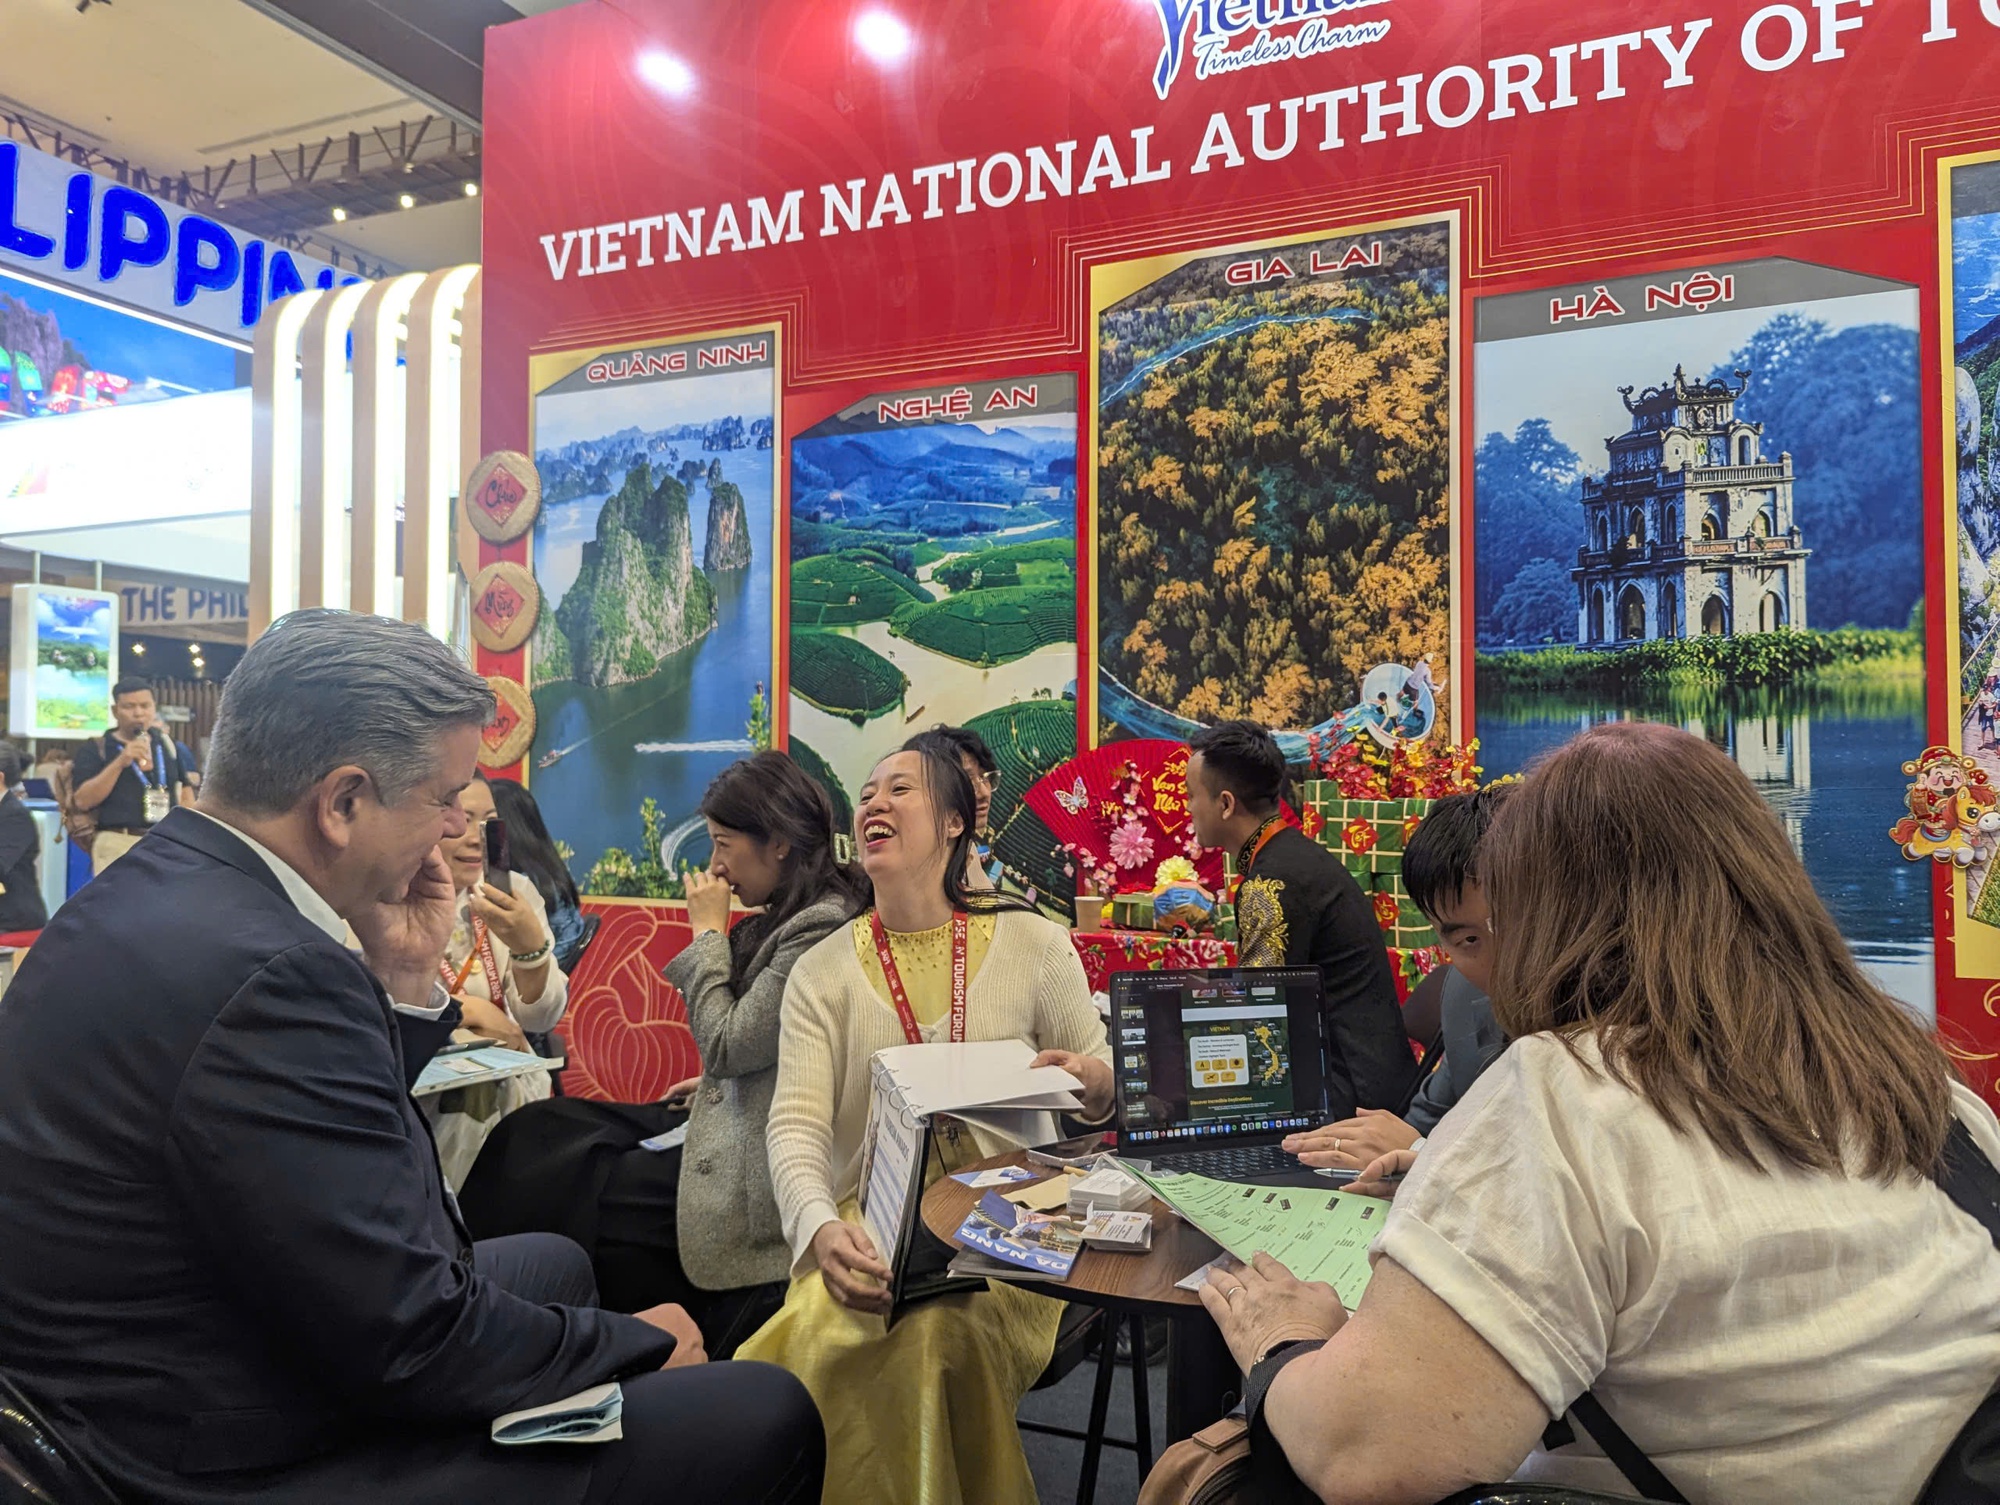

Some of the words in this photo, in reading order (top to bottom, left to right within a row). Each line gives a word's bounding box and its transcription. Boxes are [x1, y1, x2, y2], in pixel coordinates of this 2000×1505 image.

[1197, 33, 1293, 76] Timeless
[1298, 22, 1388, 55] Charm
[540, 190, 804, 281] VIETNAM
[820, 126, 1171, 237] NATIONAL
[1190, 18, 1712, 174] AUTHORITY
[1740, 0, 1873, 71] OF
[1225, 256, 1295, 286] GIA
[1310, 241, 1382, 275] LAI
[1550, 285, 1625, 324] HÀ
[1645, 271, 1734, 312] NỘI
[587, 350, 687, 383] QUẢNG
[698, 340, 767, 368] NINH
[879, 387, 972, 423] NGHỆ
[984, 384, 1038, 412] AN
[121, 586, 176, 621] THE
[483, 951, 498, 980] FORUM
[953, 956, 965, 1006] TOURISM
[960, 1227, 1027, 1261] NANG
[1034, 1256, 1069, 1271] DA
